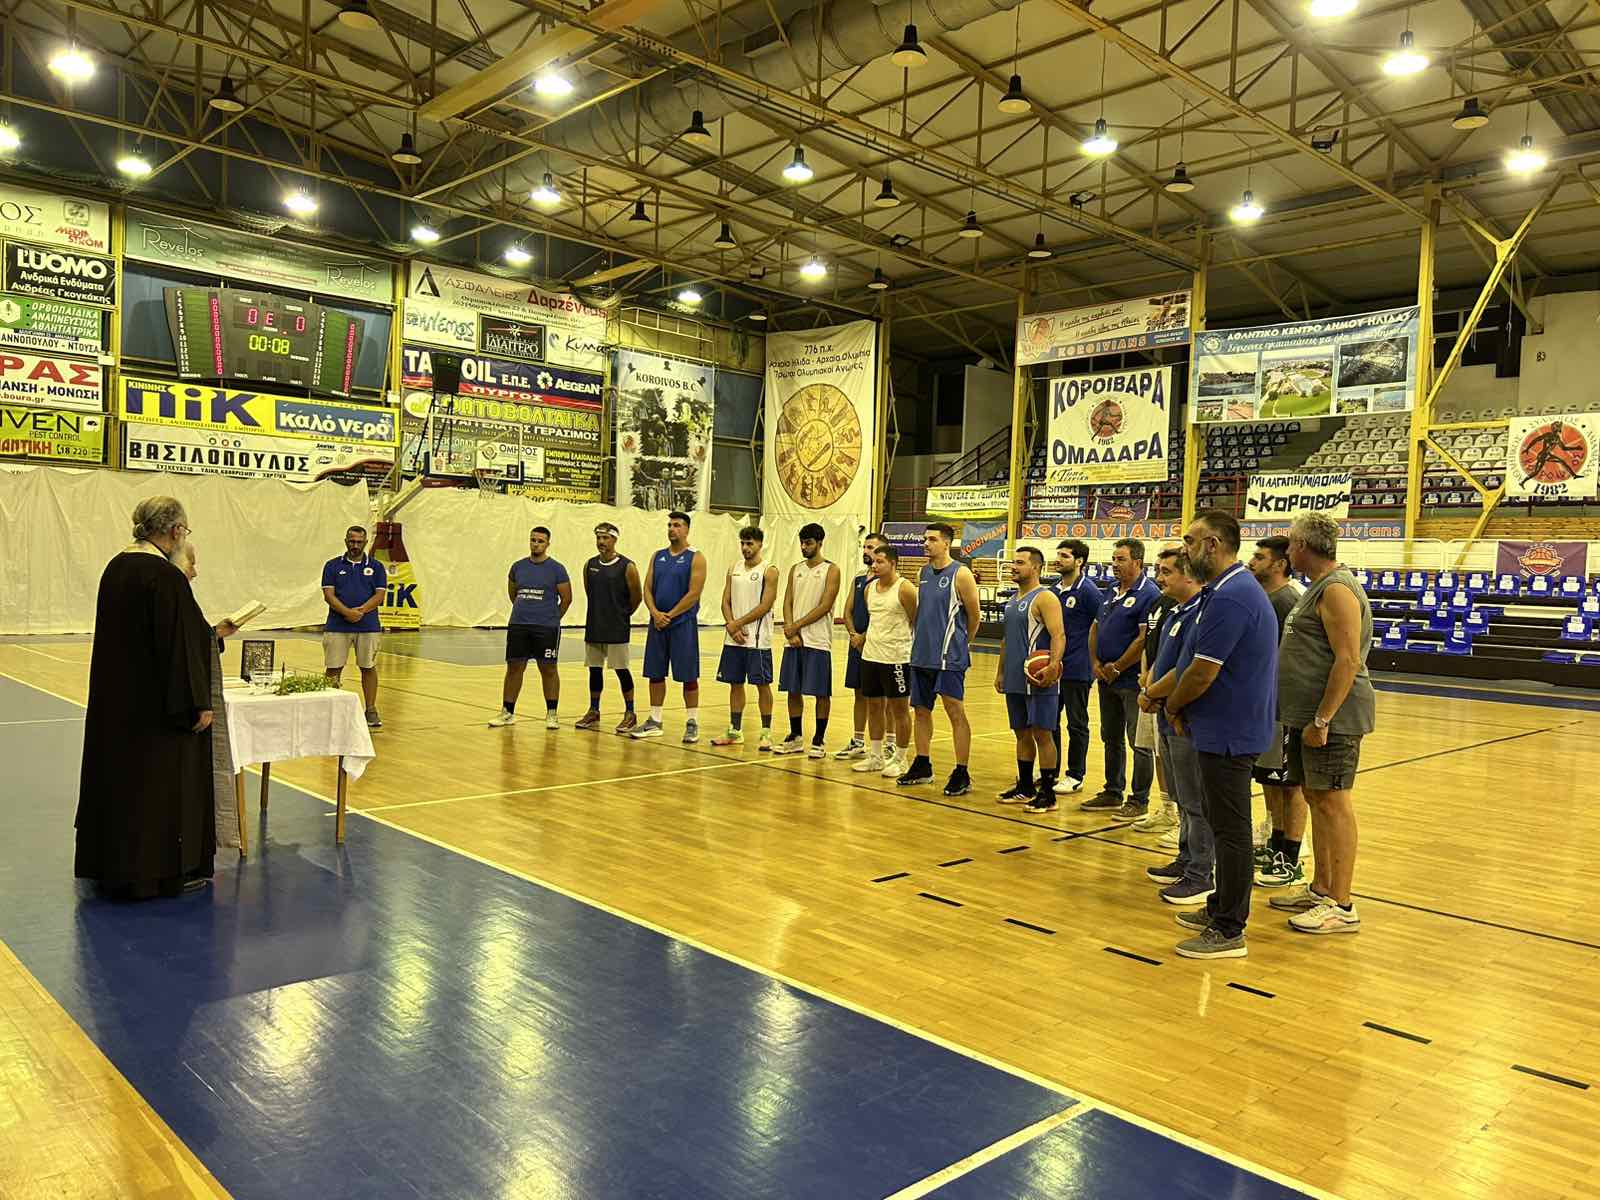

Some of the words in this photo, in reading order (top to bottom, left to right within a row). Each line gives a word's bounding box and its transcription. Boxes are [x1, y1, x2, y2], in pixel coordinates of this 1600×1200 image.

[11, 281, 55, 297] Ανδρέας
[20, 271, 59, 285] Ανδρικά
[60, 275, 105, 291] Ενδύματα
[248, 308, 258, 324] 0
[296, 316, 305, 331] 0
[1227, 328, 1280, 341] ΑΘΛΗΤΙΚΟ
[1281, 324, 1322, 336] ΚΕΝΤΡΟ
[249, 335, 290, 355] 00:08
[804, 344, 818, 355] 776
[1057, 336, 1147, 358] KOROIVIANS
[555, 378, 600, 396] AEGEAN
[635, 371, 681, 389] KOROIVOS
[0, 380, 37, 394] ΑΝΣΗ
[47, 385, 98, 400] ΜΟΝΩΣΗ
[471, 386, 543, 402] ΠΥΡΓΟΣ
[1053, 370, 1165, 420] ΚΟΡΟΙΒΑΡΑ
[534, 425, 599, 441] ΓΕΡΑΣΙΜΟΣ
[129, 441, 309, 472] ΒΑΣΙΛΟΠΟΥΛΟΣ
[499, 443, 537, 456] ΟΜΗΡΟΣ
[1052, 432, 1164, 465] ΟΜΑΔΑΡΑ
[1534, 483, 1568, 495] 1982
[1022, 523, 1182, 538] KOROIVIANS
[544, 649, 556, 658] 24
[893, 664, 906, 693] adida
